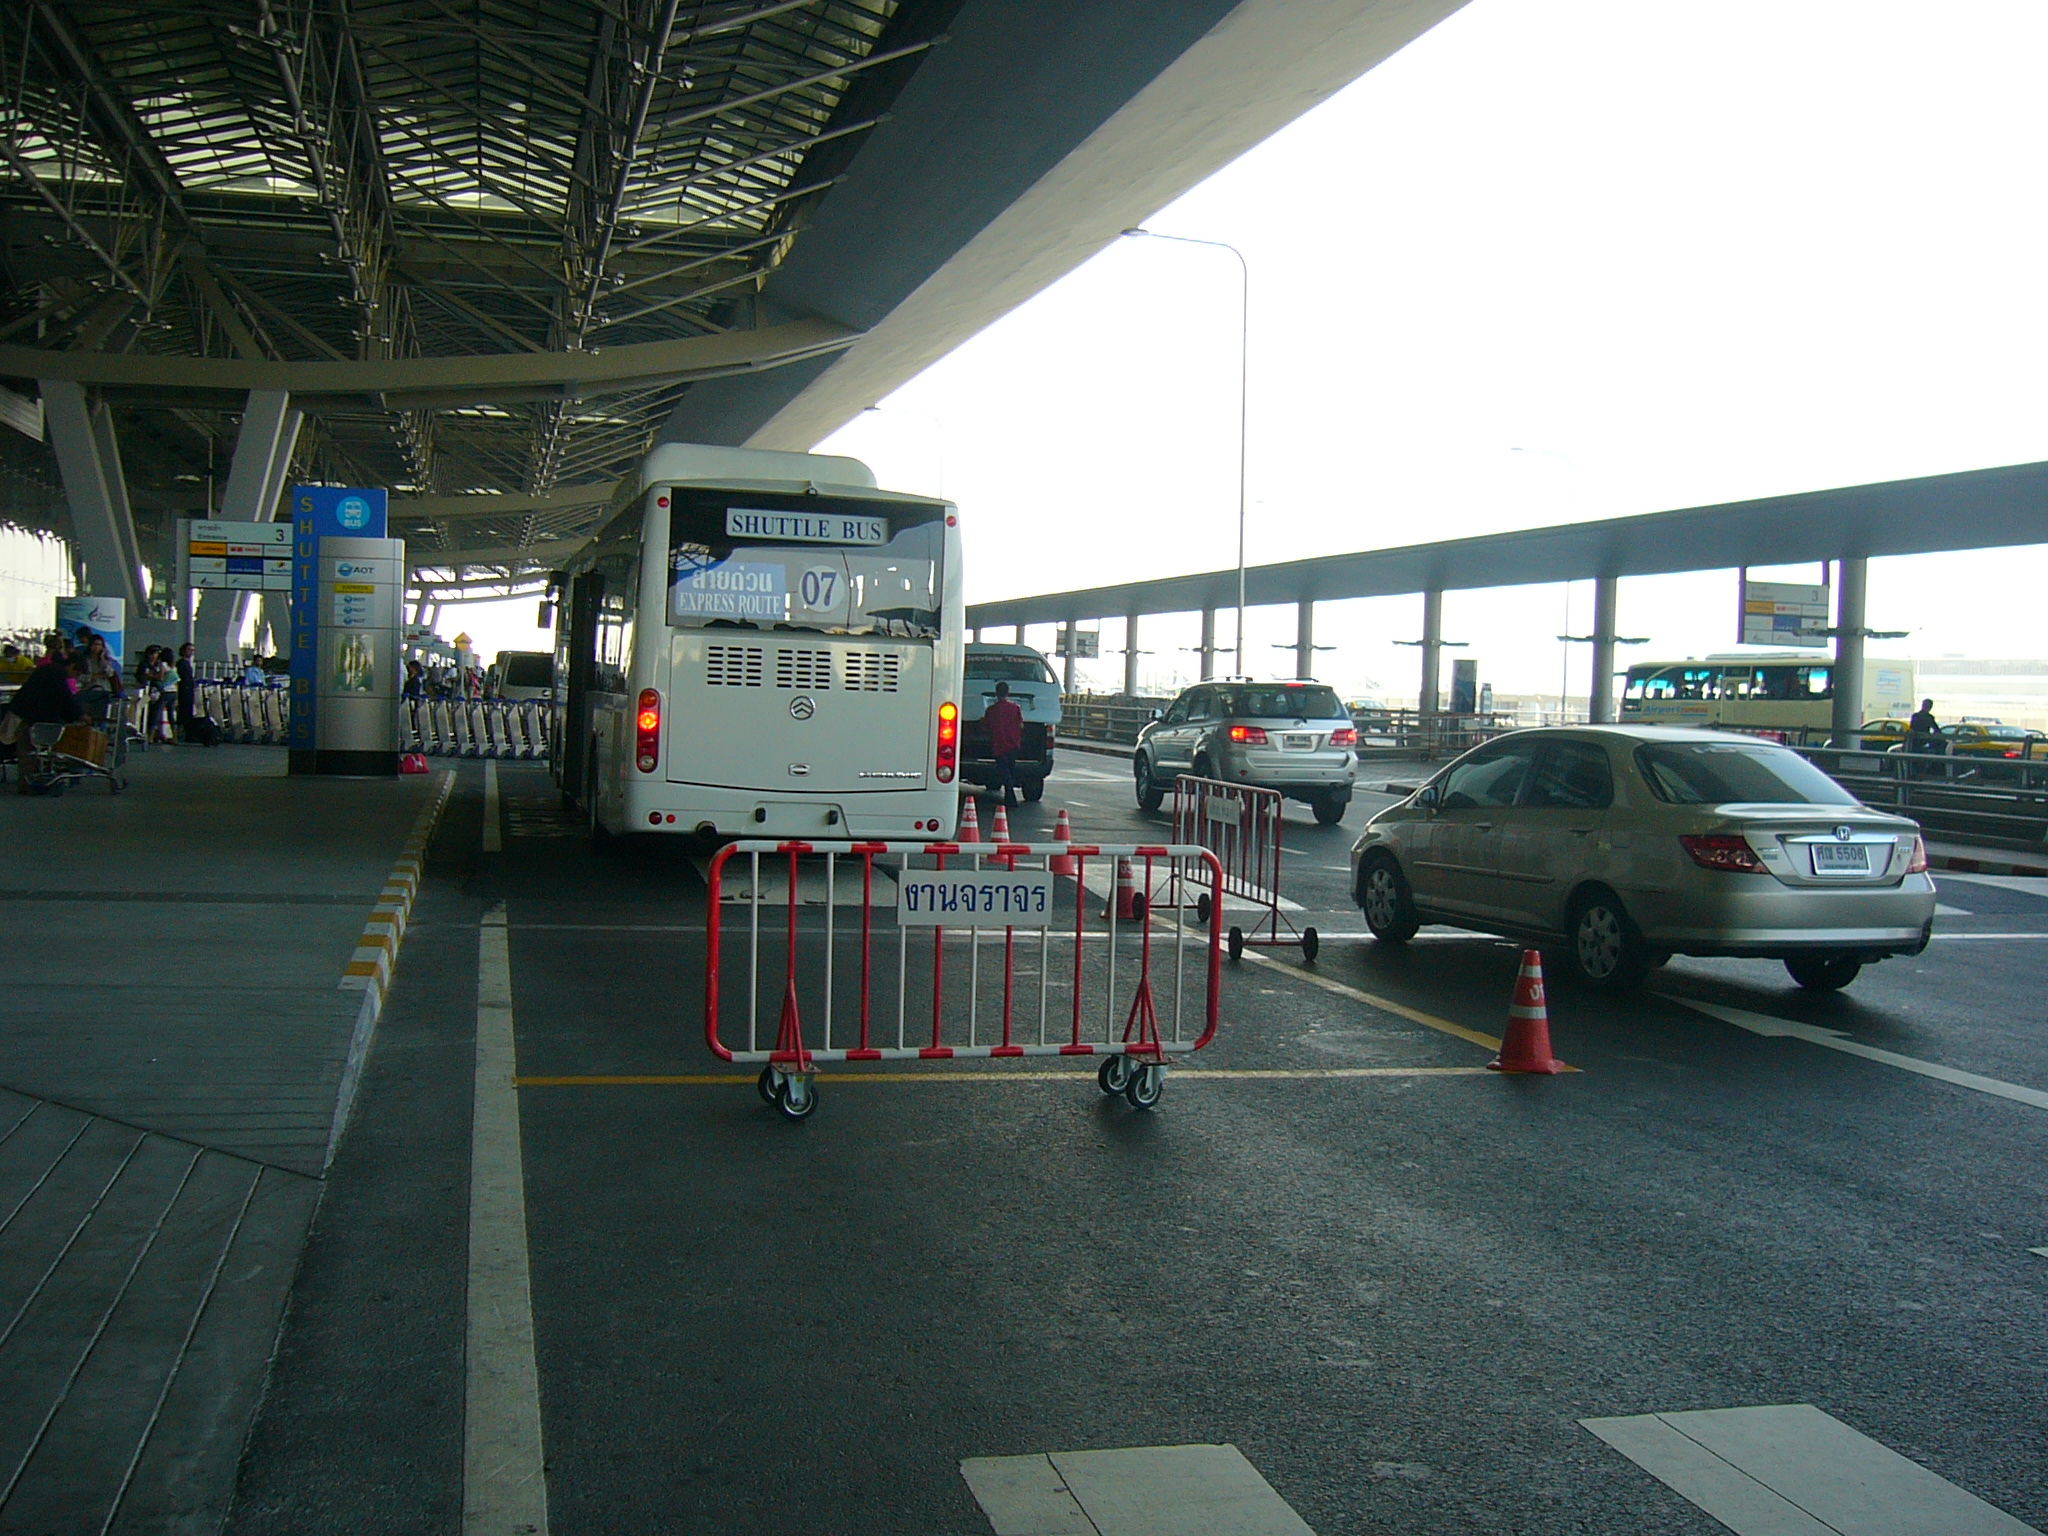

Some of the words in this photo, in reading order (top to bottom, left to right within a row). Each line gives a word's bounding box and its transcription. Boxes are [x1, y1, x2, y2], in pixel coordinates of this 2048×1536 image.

[275, 529, 285, 542] 3
[731, 514, 831, 538] SHUTTLE
[842, 519, 882, 542] BUS
[296, 497, 314, 649] SHUTTLE
[353, 566, 376, 574] AOT
[691, 564, 774, 592] สายด่วน
[679, 587, 734, 613] EXPRESS
[738, 590, 782, 615] ROUTE
[801, 571, 837, 607] 07
[294, 678, 310, 740] BUS
[1643, 704, 1681, 716] Airport
[1836, 846, 1864, 861] 5506
[905, 884, 1046, 912] งานจราจร
